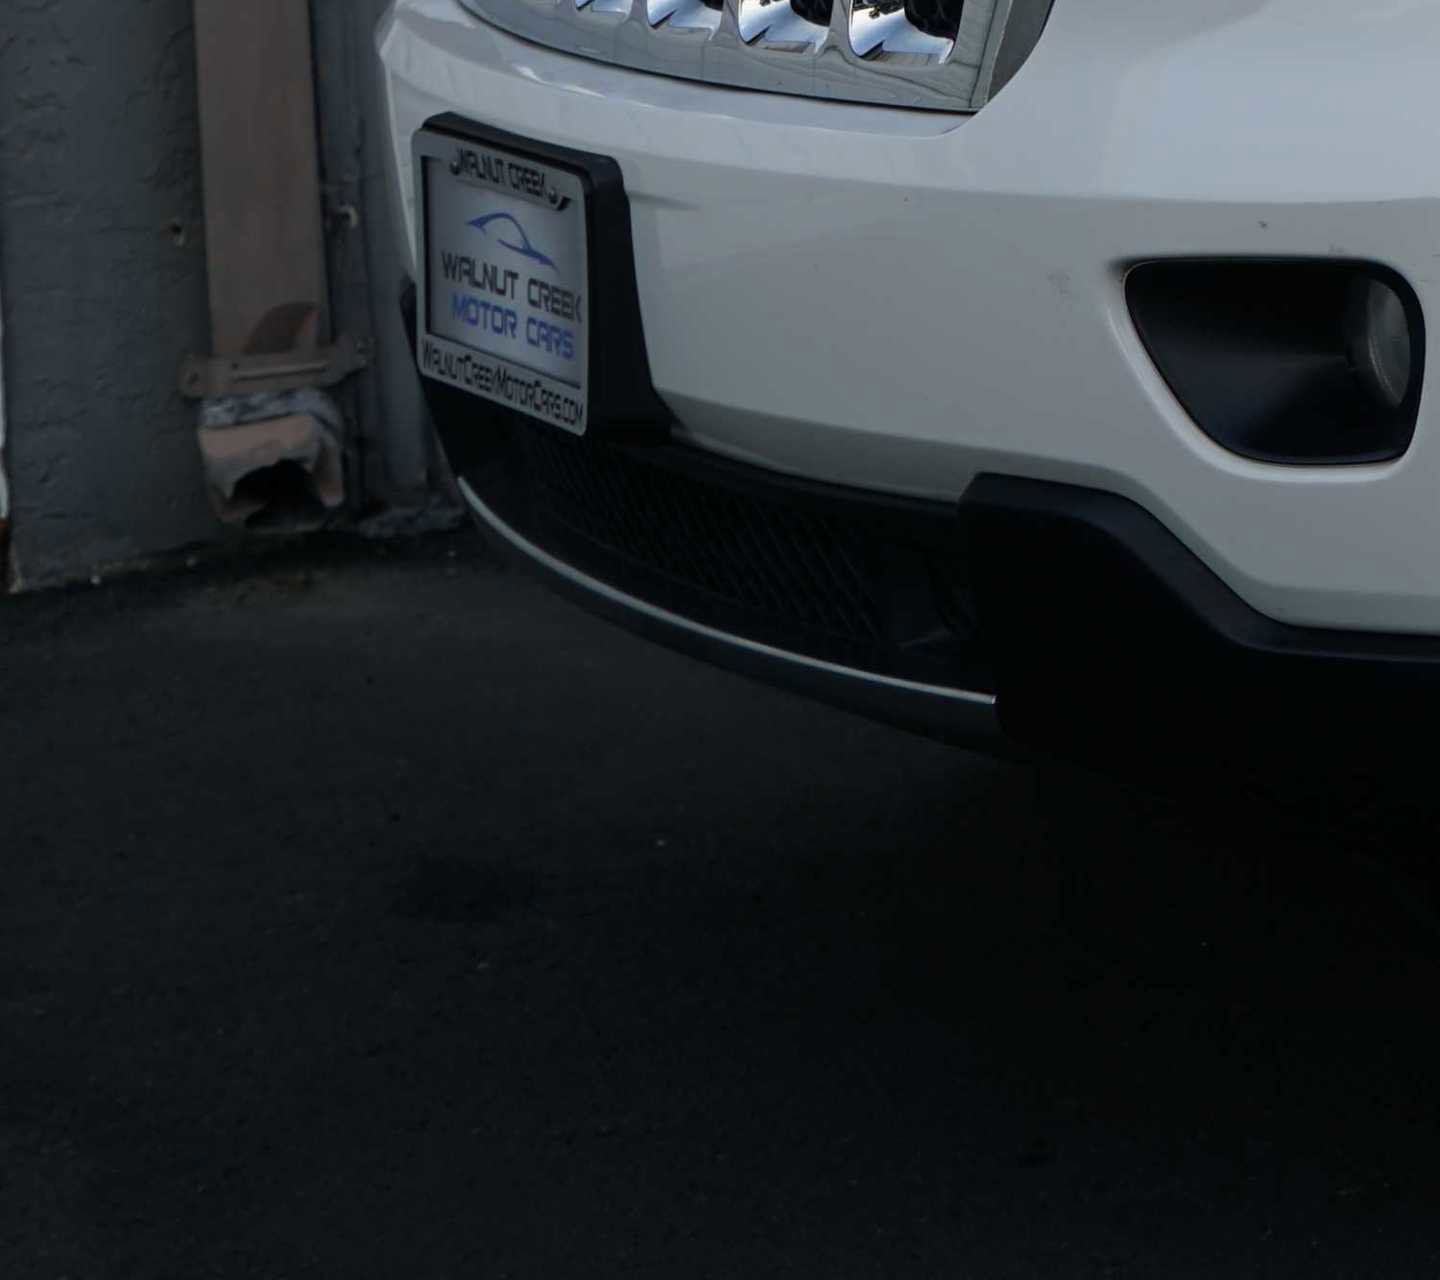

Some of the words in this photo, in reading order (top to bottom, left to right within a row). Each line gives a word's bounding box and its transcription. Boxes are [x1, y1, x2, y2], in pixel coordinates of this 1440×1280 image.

[456, 148, 505, 183] WALNUT
[441, 251, 519, 300] WALNUT
[527, 278, 582, 322] CREEK
[452, 294, 517, 338] MOTOR
[526, 315, 576, 359] CARS
